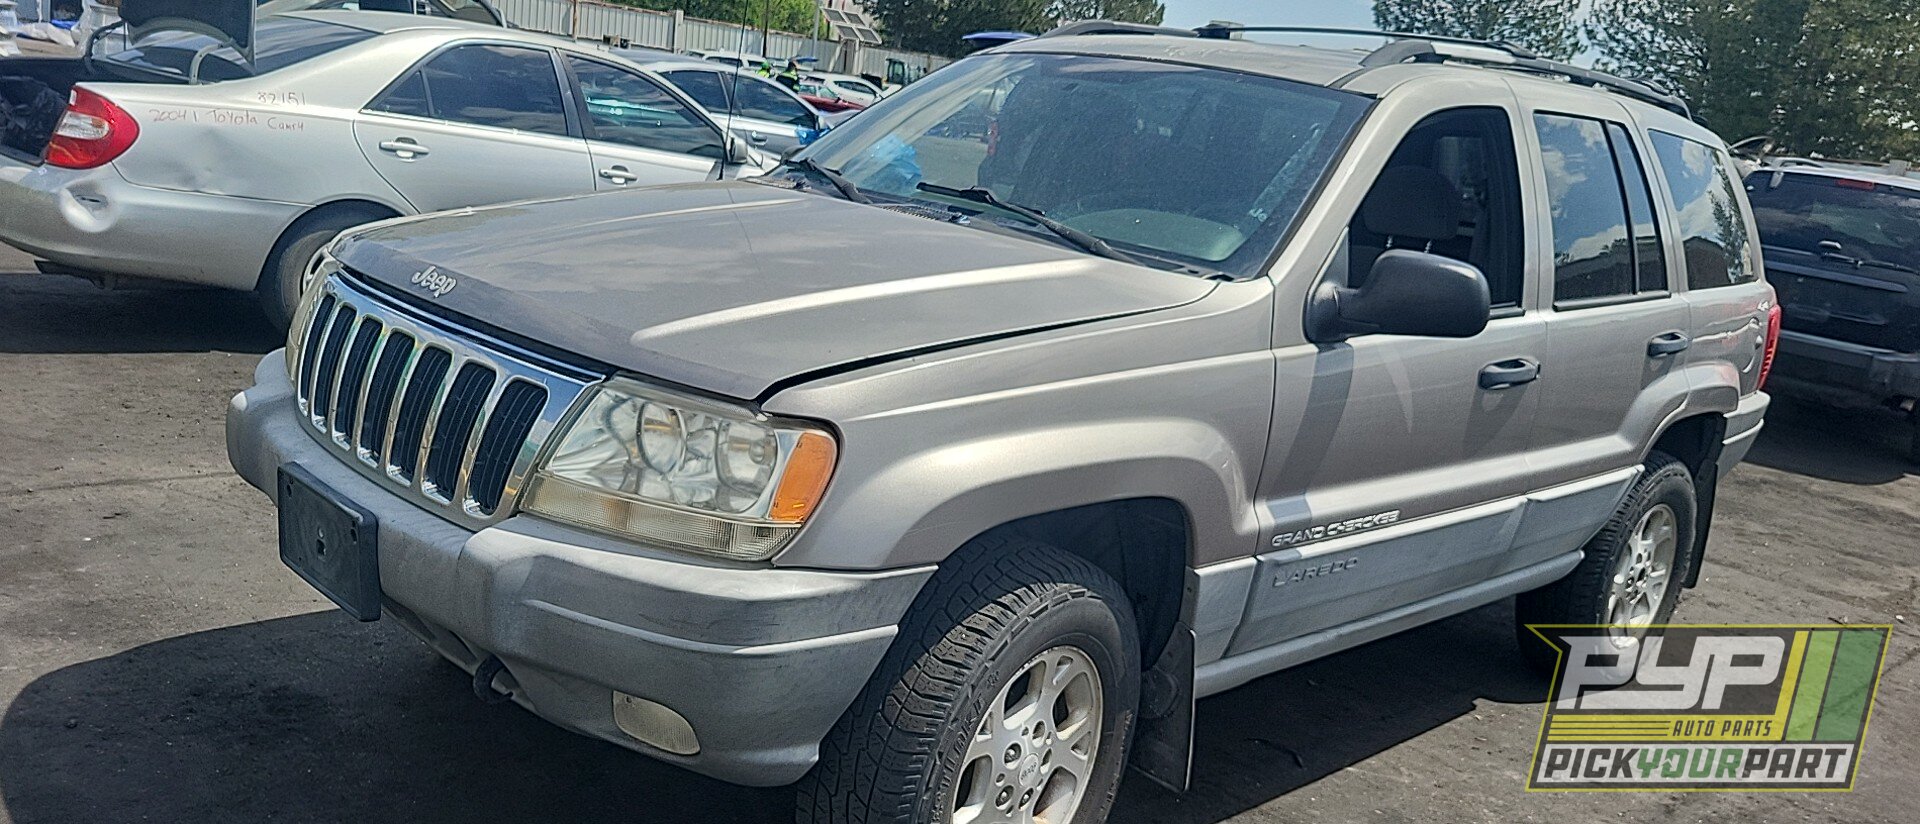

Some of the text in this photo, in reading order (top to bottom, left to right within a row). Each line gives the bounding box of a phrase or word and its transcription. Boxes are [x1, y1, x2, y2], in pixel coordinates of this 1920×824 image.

[411, 265, 457, 298] Jeep
[1271, 509, 1401, 547] GRAND CHEROKEE
[1272, 556, 1359, 588] LAREDO
